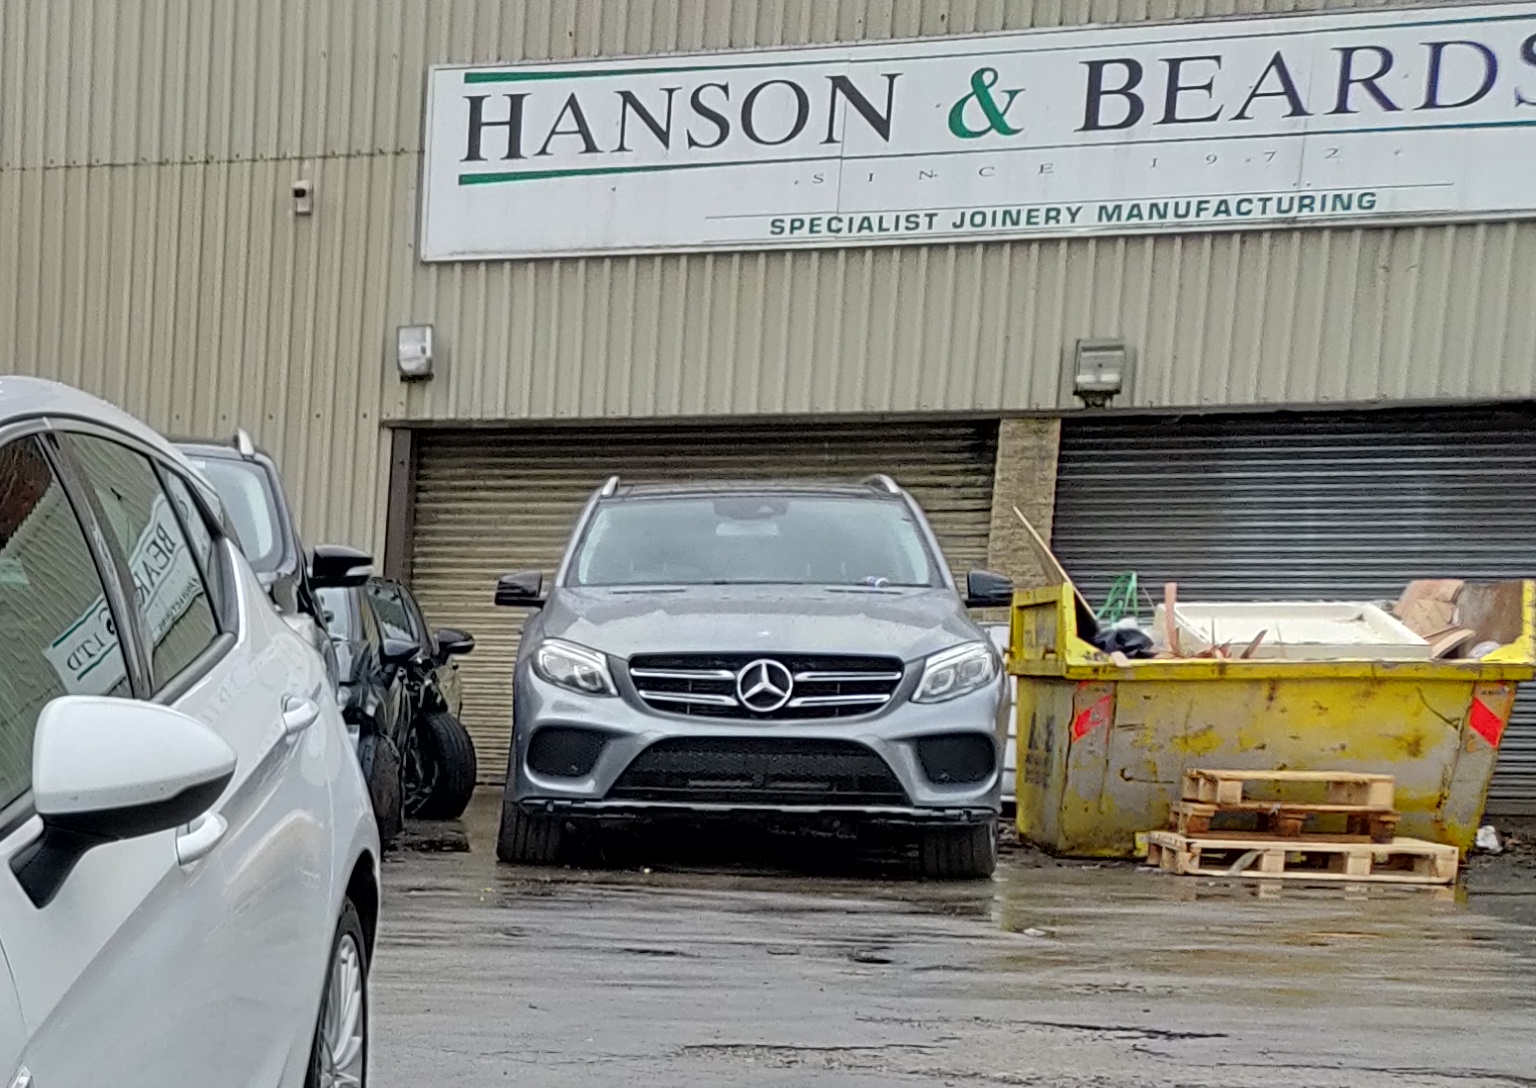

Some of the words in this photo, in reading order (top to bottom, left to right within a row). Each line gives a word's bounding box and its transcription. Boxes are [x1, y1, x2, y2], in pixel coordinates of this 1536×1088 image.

[460, 72, 904, 162] HANSON
[948, 67, 1026, 139] &
[769, 212, 939, 236] SPECIALIST
[952, 206, 1084, 230] JOINERY
[1096, 191, 1379, 223] MANUFACTURING
